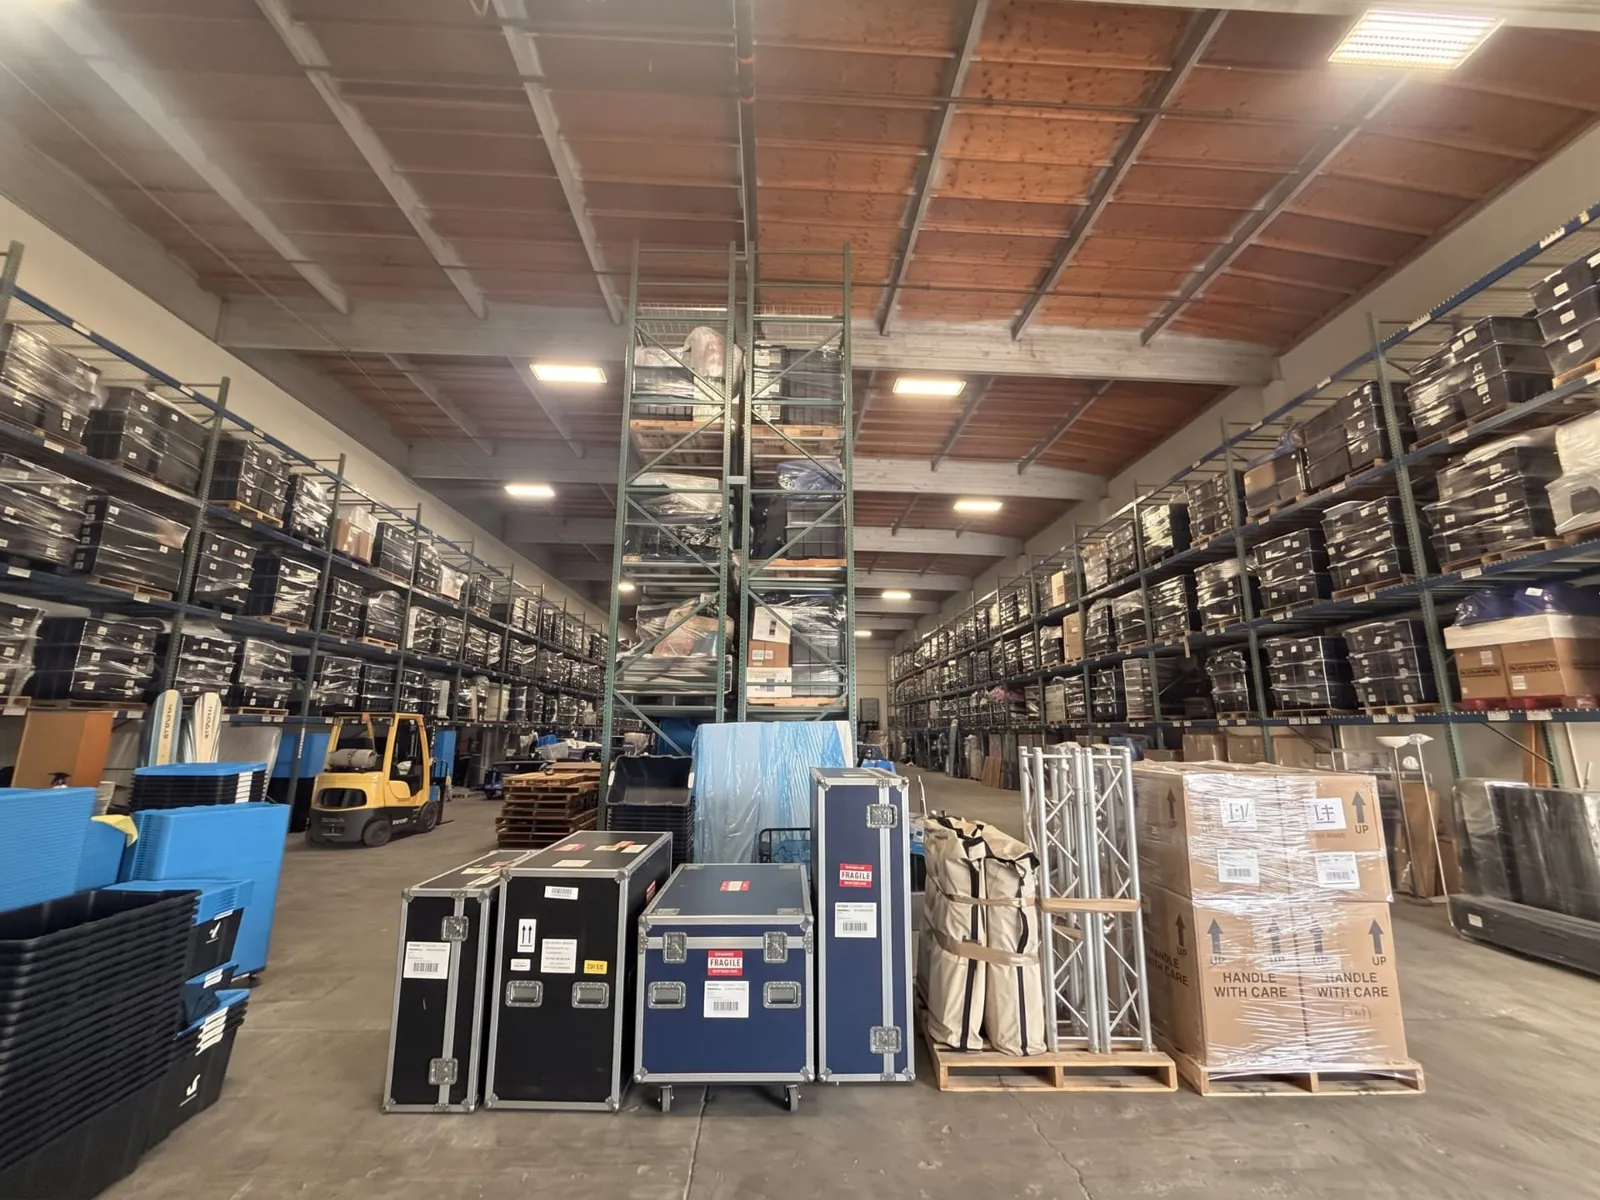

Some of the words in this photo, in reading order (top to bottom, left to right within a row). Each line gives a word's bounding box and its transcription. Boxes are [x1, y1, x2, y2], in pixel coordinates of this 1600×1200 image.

[1354, 825, 1369, 834] UP
[841, 871, 870, 880] FRAGILE
[710, 958, 741, 967] FRAGILE
[1372, 956, 1387, 966] UP
[1223, 972, 1277, 983] HANDLE
[1325, 972, 1378, 983] HANDLE
[1213, 986, 1248, 998] WITH
[1251, 986, 1288, 998] CARE
[1317, 986, 1350, 998] WITH
[1353, 986, 1389, 998] CARE
